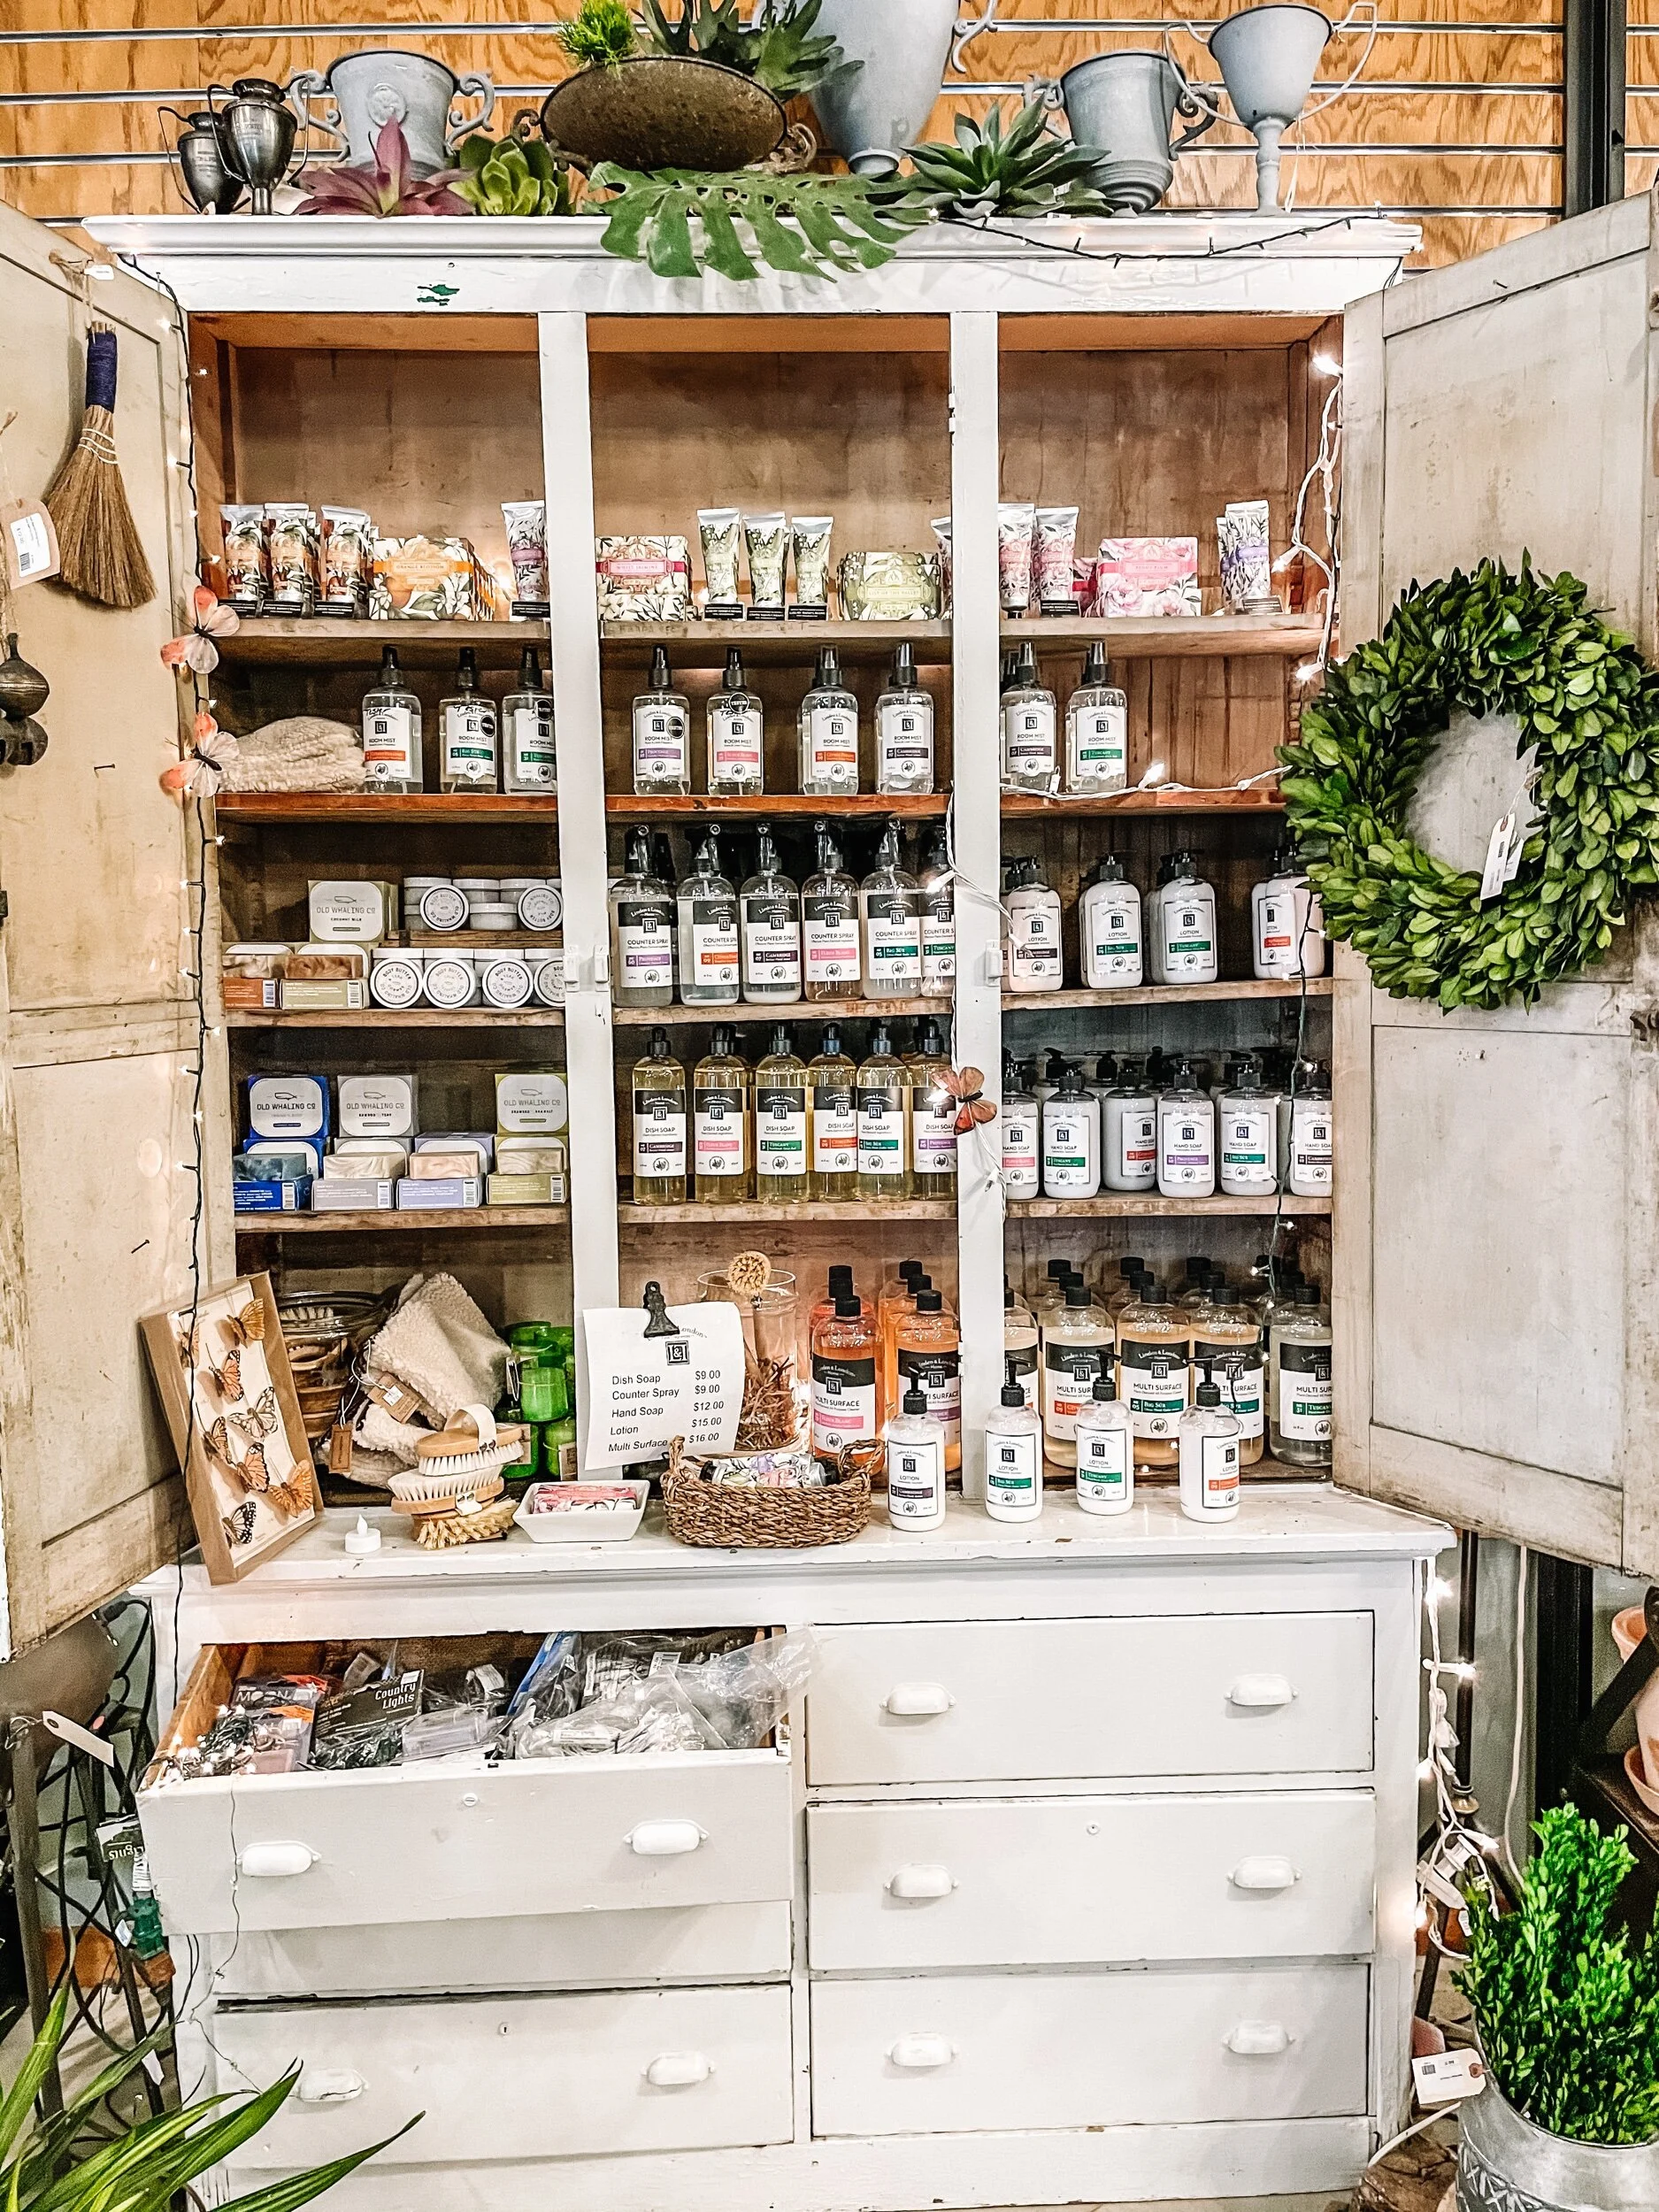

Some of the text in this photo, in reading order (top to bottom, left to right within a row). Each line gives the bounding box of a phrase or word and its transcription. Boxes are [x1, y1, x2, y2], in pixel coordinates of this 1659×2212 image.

[383, 968, 411, 979] BODY BUTTER
[495, 968, 523, 979] BODY BUTTER
[680, 1327, 703, 1338] ondon
[1061, 1352, 1079, 1362] Linden
[1083, 1351, 1100, 1361] Londo
[1163, 1349, 1180, 1359] London
[612, 1370, 720, 1386] Dish Soap $9.00
[612, 1385, 720, 1401] Counter Spray $9.00
[815, 1394, 828, 1403] MULTI
[933, 1390, 958, 1399] SURFACE
[612, 1402, 724, 1418] Hand Soap $12.00
[611, 1417, 721, 1435] Lotion $15.00
[609, 1432, 719, 1452] Multi Surface $16.00
[375, 1682, 416, 1701] Country
[382, 1694, 415, 1709] Lights
